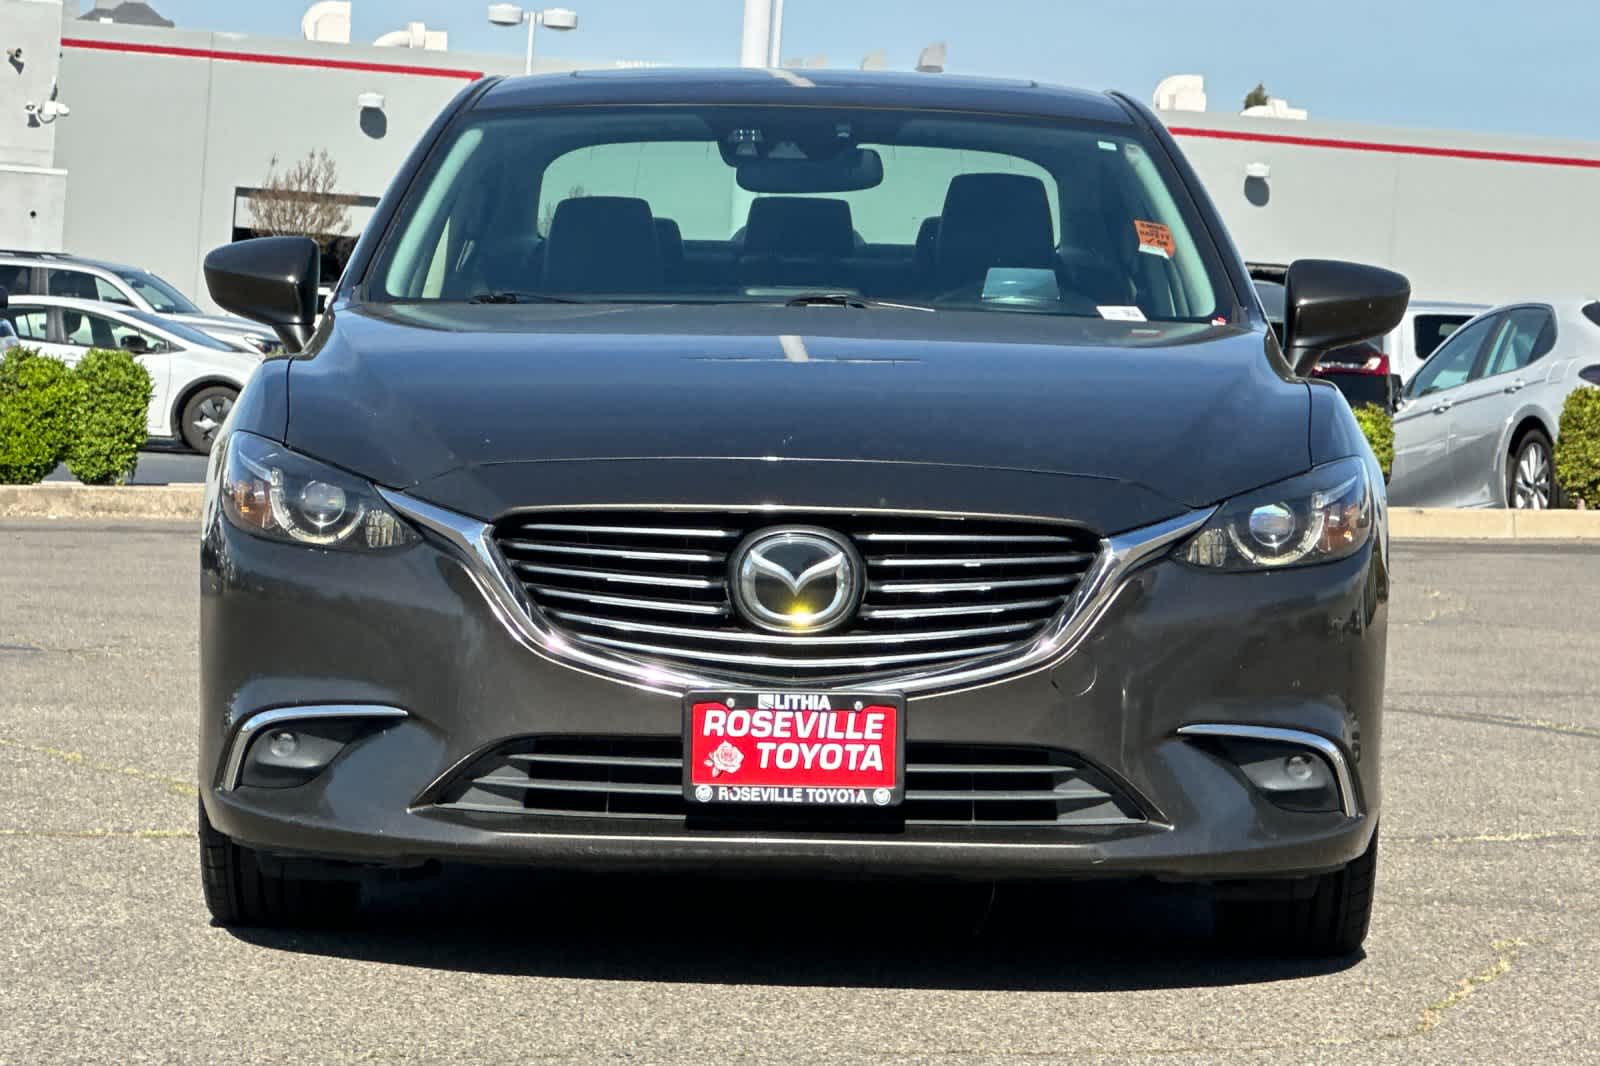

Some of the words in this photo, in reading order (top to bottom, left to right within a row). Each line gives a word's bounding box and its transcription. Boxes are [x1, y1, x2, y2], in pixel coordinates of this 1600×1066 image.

[775, 694, 831, 710] LITHIA
[703, 710, 885, 739] ROSEVILLE
[757, 742, 883, 771] TOYOTA
[718, 786, 802, 802] ROSEVILLE
[806, 788, 867, 804] TOYOTA
